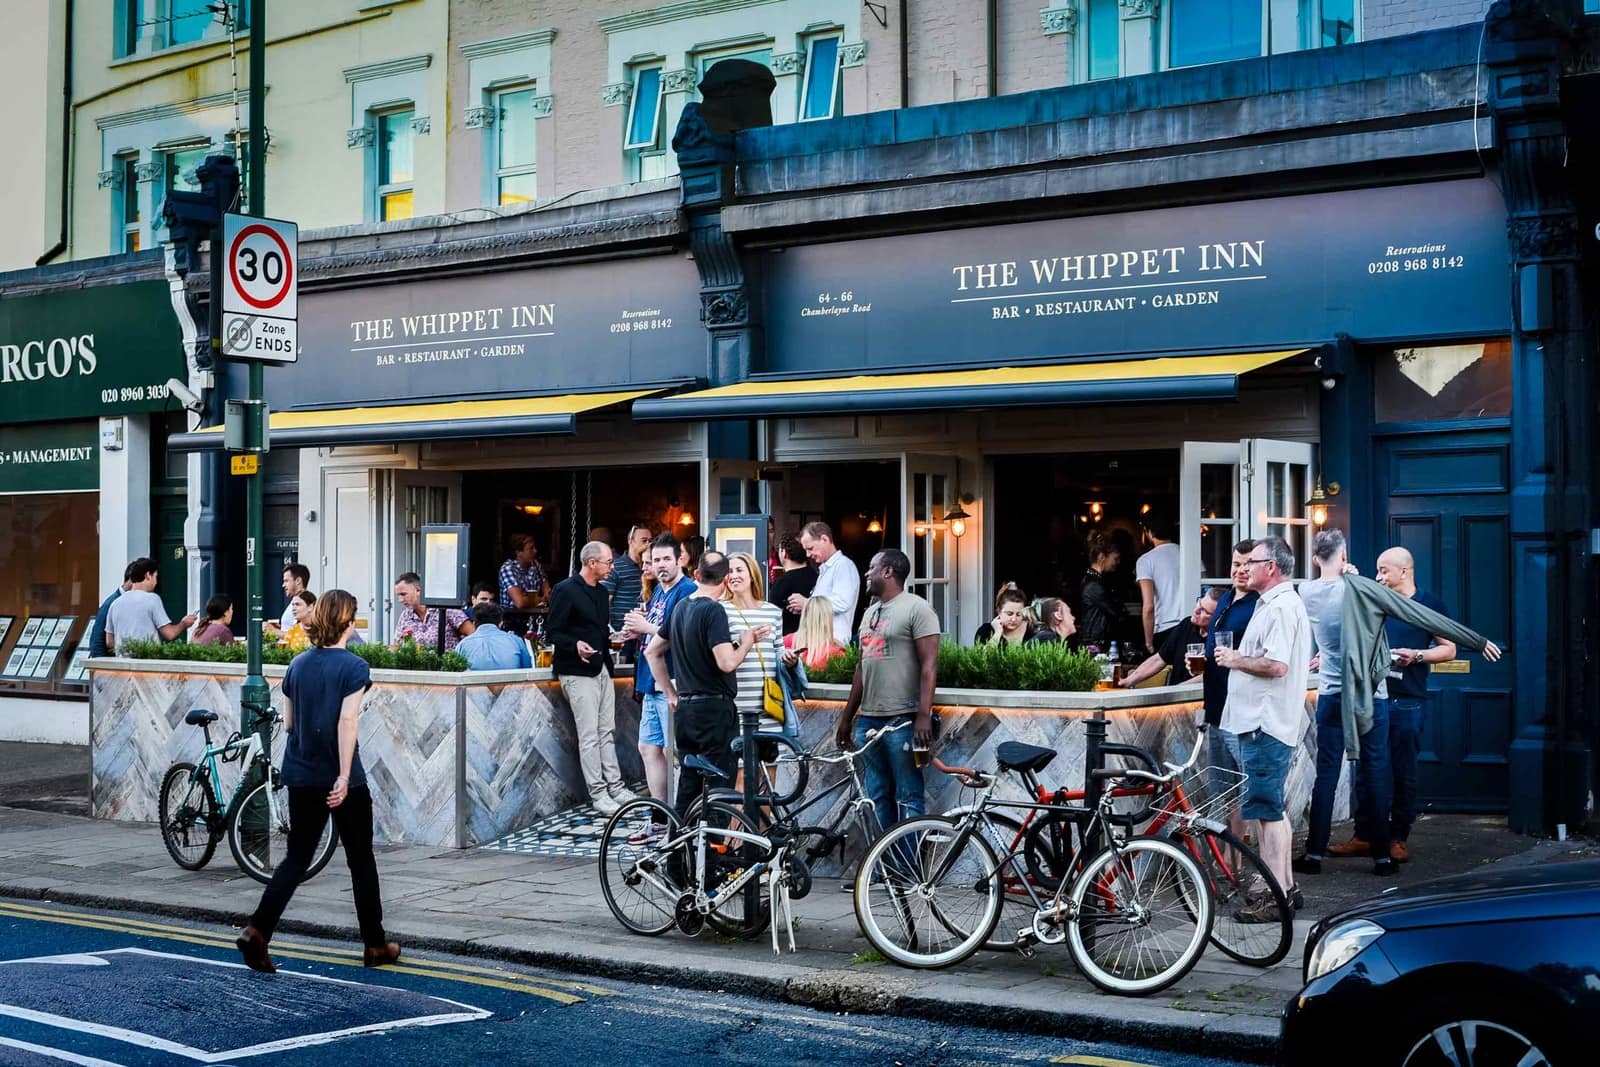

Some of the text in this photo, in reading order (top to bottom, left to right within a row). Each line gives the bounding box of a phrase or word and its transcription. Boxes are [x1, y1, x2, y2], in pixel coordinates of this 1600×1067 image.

[1385, 242, 1446, 257] Reservations
[238, 247, 284, 285] 30
[951, 239, 1266, 292] THE WHIPPET INN
[1368, 255, 1465, 274] 0208 968 8142
[818, 292, 831, 304] 64
[841, 291, 853, 302] 66
[991, 290, 1220, 320] BAR RESTAURANT GARDEN
[622, 307, 661, 319] Reservations
[801, 303, 872, 317] Chamberlayne Road
[262, 322, 286, 334] Zone
[350, 303, 556, 343] THE WHIPPET INN
[610, 318, 672, 333] 0208 968 8142
[255, 336, 292, 352] ENDS
[0, 333, 97, 383] RGO'S
[376, 343, 526, 367] BAR RESTAURANT GARDEN
[101, 383, 170, 404] 020 8960 3030
[12, 446, 93, 464] MANAGEMENT
